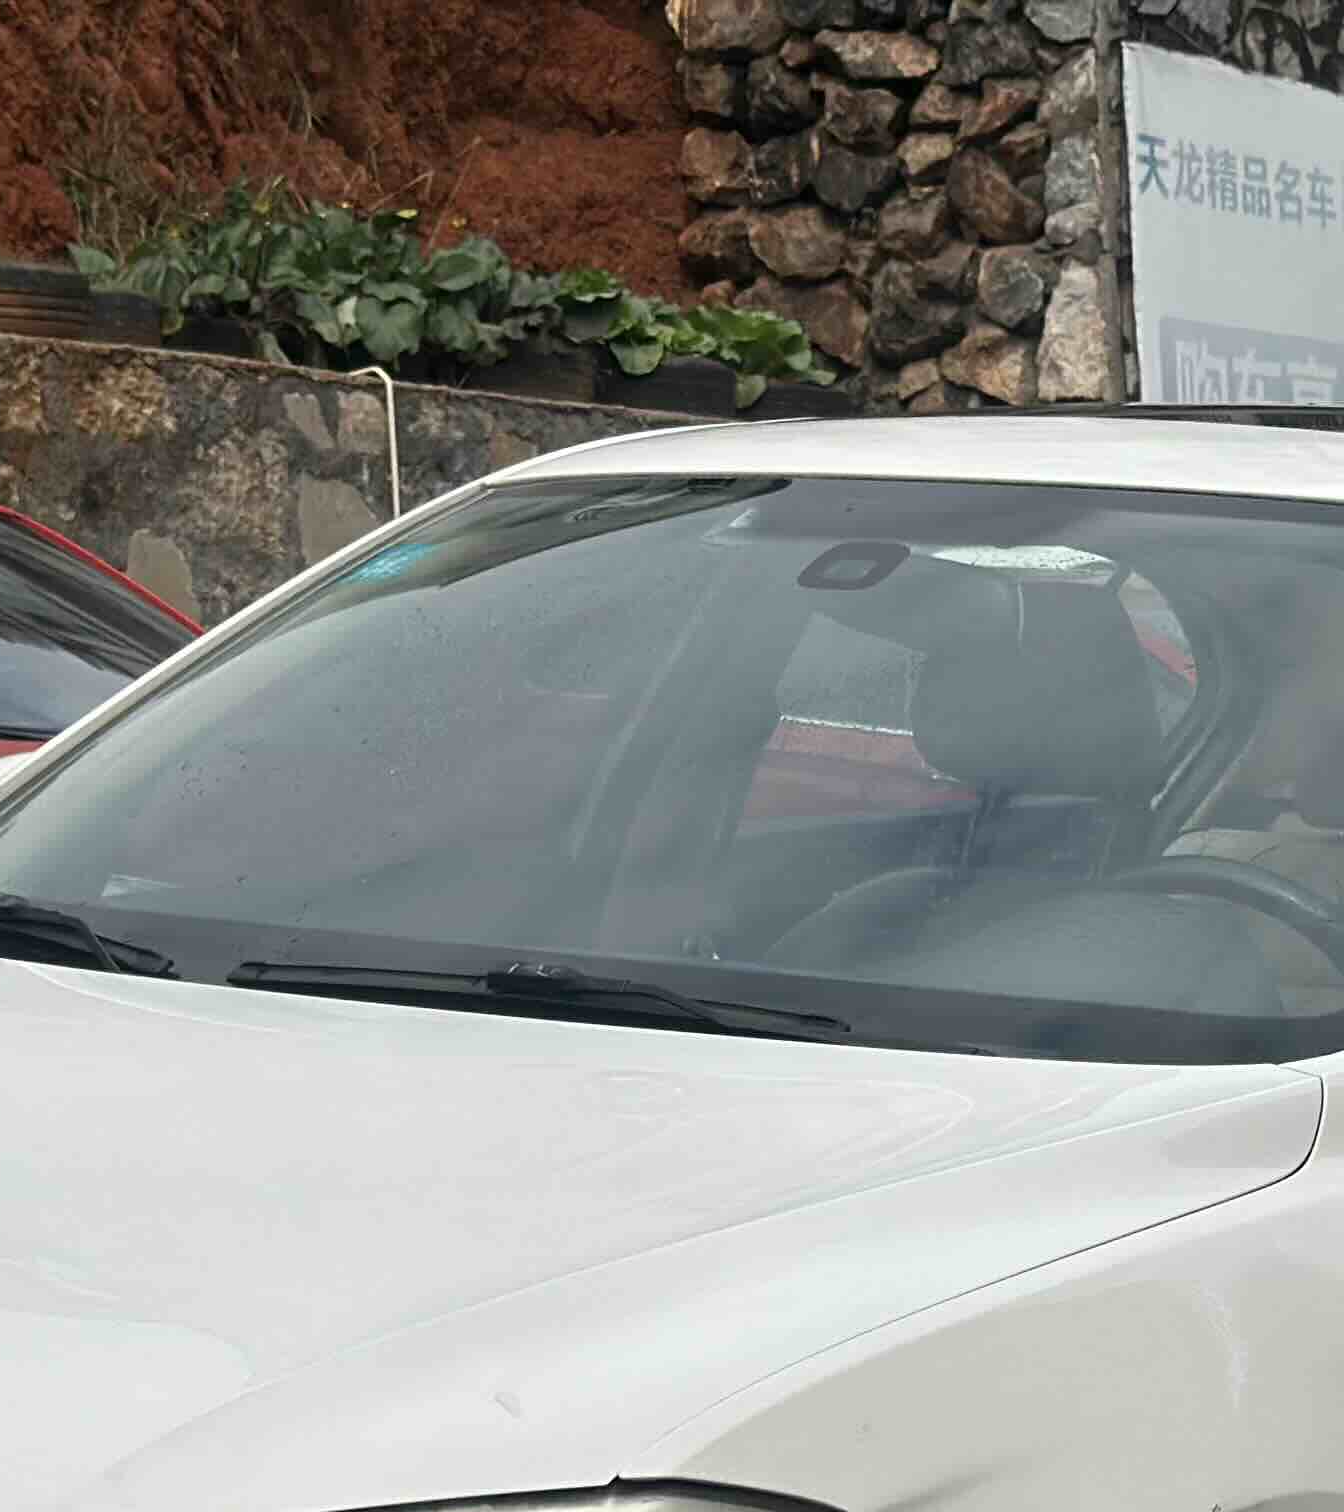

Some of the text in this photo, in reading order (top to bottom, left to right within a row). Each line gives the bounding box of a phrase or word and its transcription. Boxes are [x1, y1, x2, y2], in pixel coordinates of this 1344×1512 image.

[1136, 133, 1337, 229] 天龙精品名车
